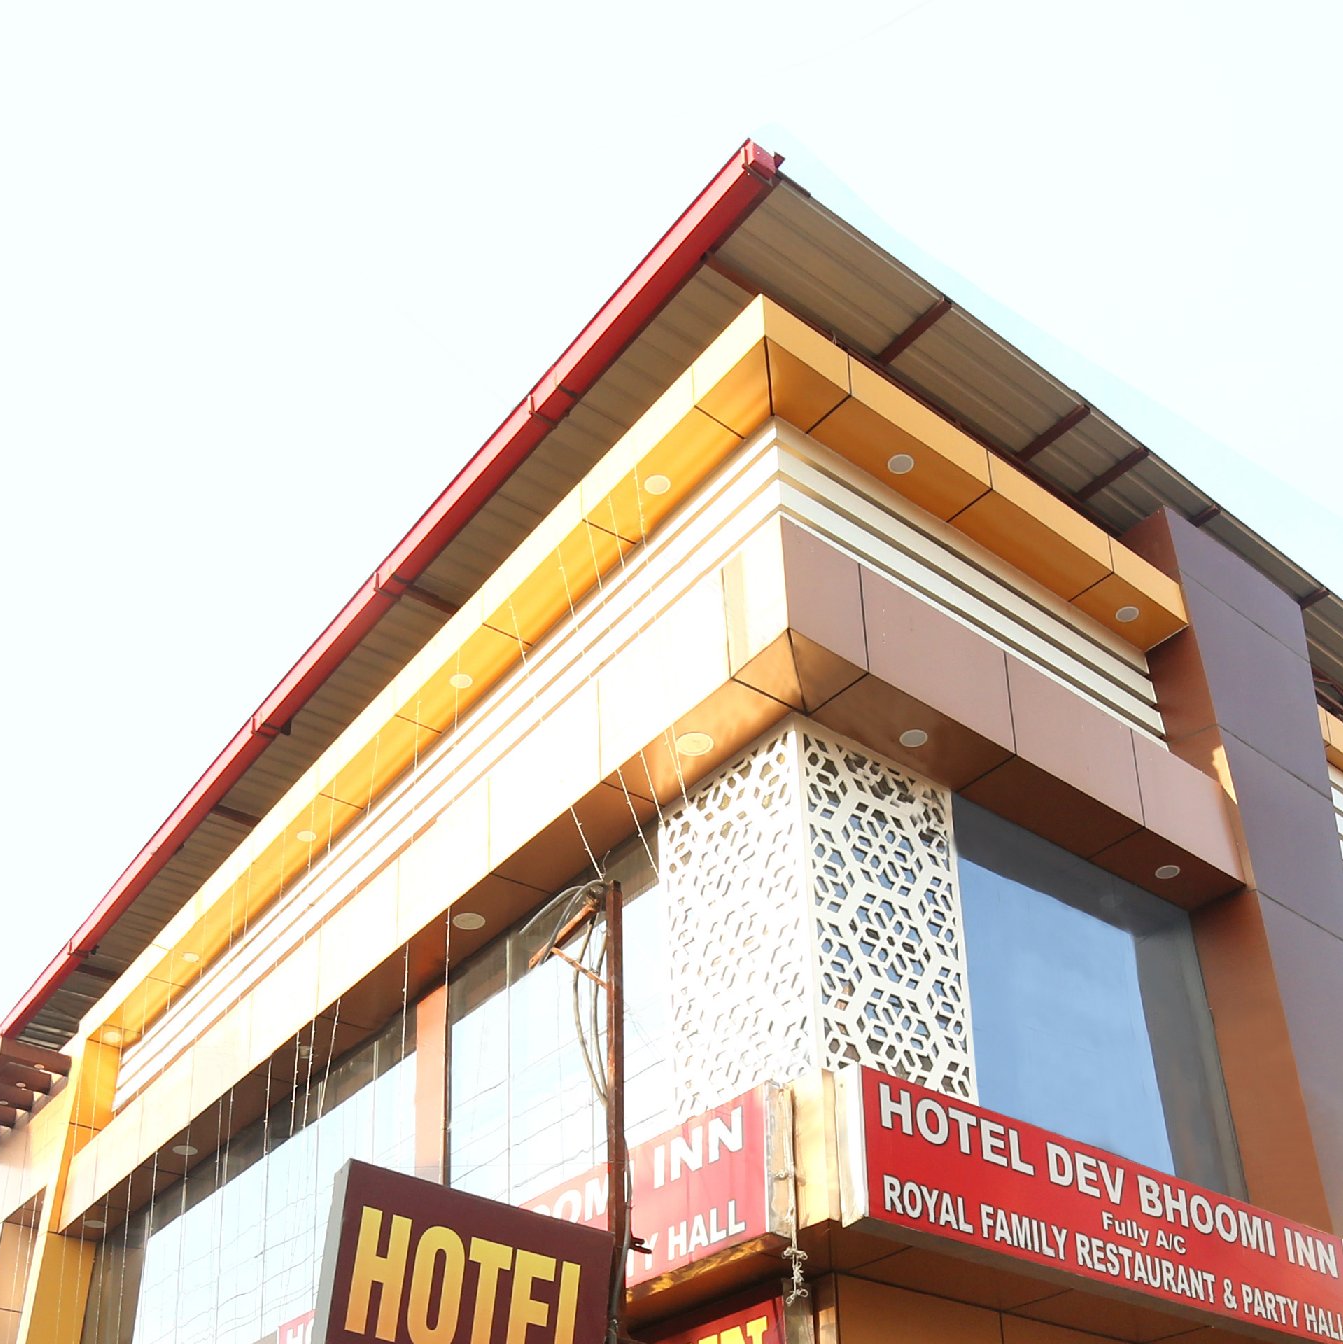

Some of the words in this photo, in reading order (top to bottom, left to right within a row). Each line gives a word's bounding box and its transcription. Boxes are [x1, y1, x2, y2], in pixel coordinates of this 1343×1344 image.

[654, 1105, 743, 1189] INN
[879, 1082, 1034, 1177] HOTEL
[1047, 1141, 1124, 1205] DEV
[1138, 1175, 1276, 1257] BHOOMI
[1284, 1227, 1339, 1279] INN
[668, 1200, 746, 1261] HALL
[883, 1174, 975, 1233] ROYAL
[980, 1203, 1067, 1261] FAMILY
[1075, 1233, 1215, 1304] RESTAURANT
[1223, 1279, 1237, 1310] &
[1242, 1284, 1300, 1329] PARTY
[1102, 1211, 1150, 1249] Fully
[1156, 1229, 1187, 1255] A/C
